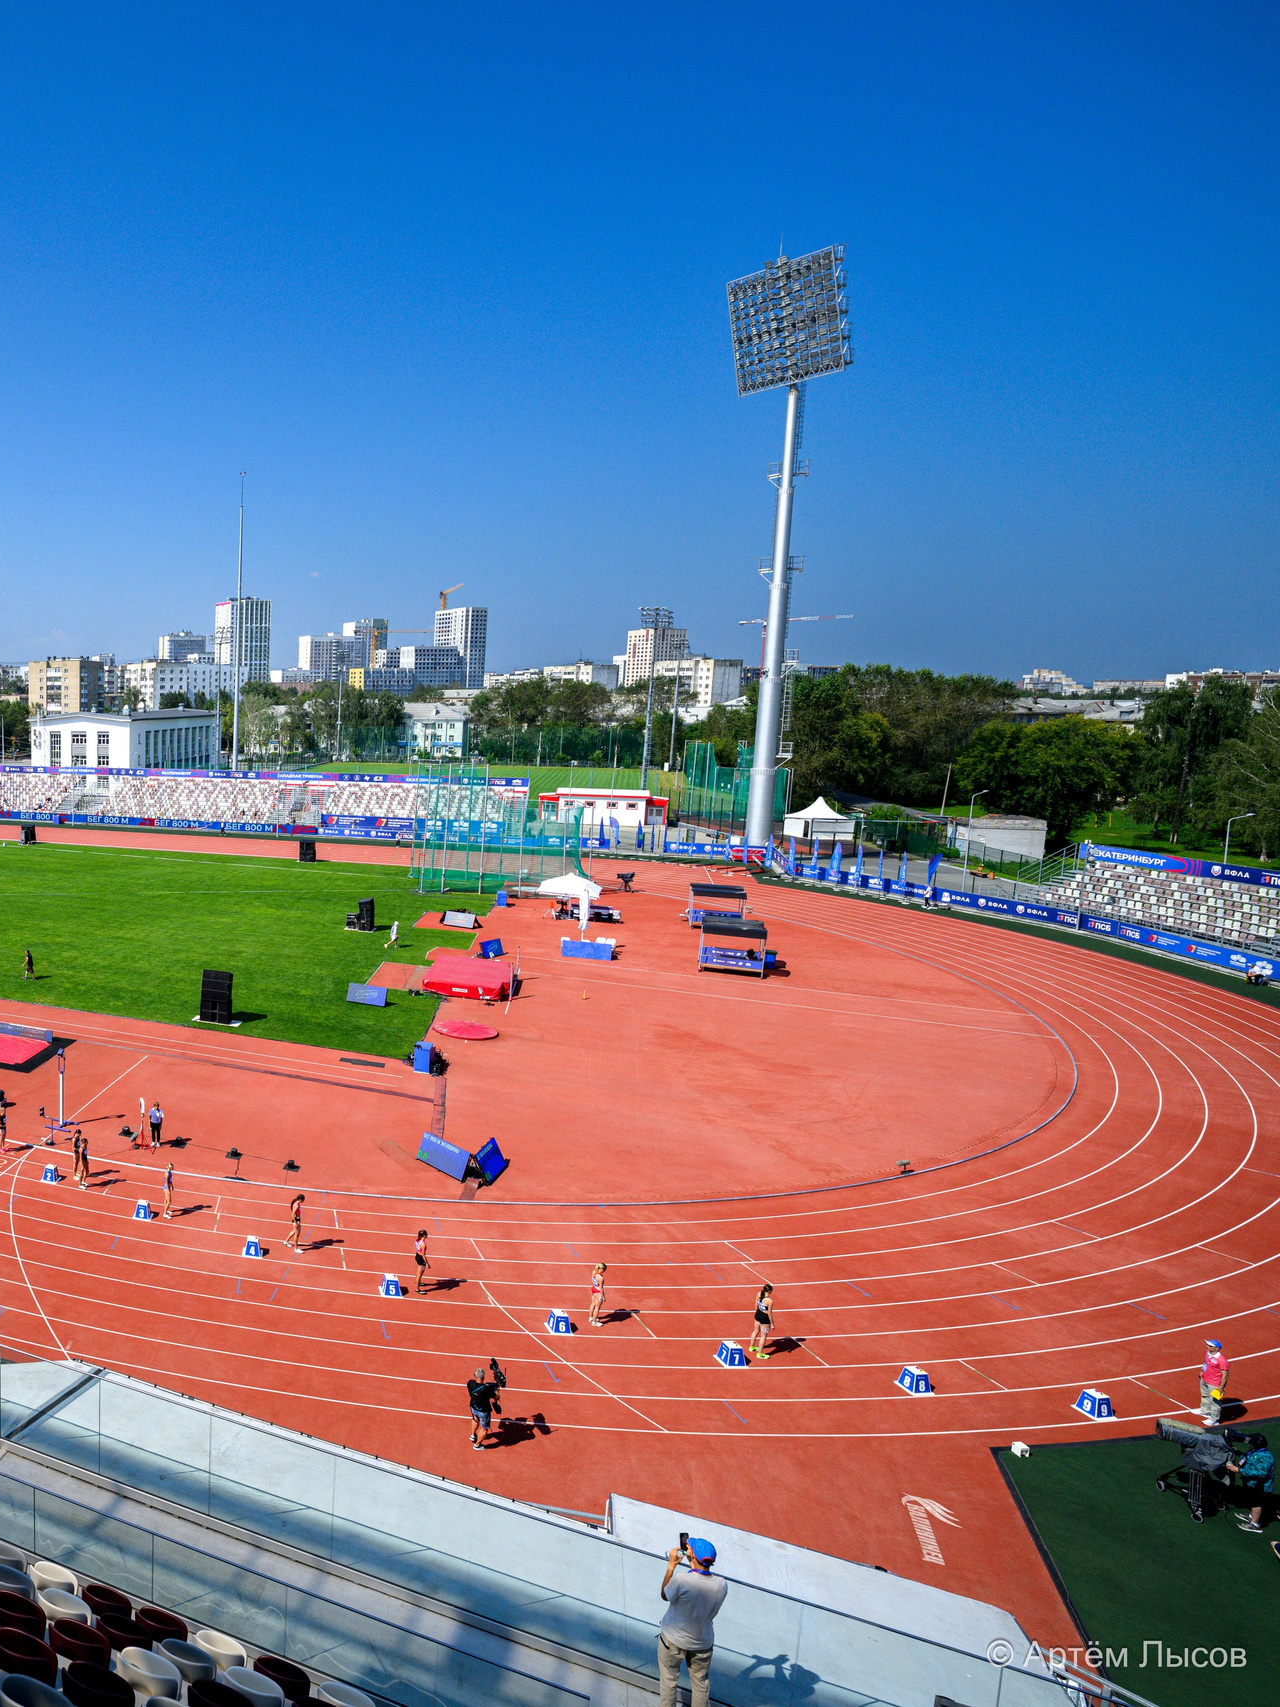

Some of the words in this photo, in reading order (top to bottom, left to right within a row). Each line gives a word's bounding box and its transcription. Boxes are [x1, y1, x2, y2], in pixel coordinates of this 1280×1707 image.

[20, 812, 35, 820] БЕГ
[103, 816, 119, 824] 800
[171, 820, 189, 828] 800
[225, 822, 242, 830] БЕГ
[244, 824, 263, 832] 800
[1095, 849, 1167, 867] ЕКАТЕРИНБУРГ
[1224, 869, 1250, 879] ВФЛА
[951, 894, 971, 903] ВФЛА
[987, 901, 1008, 910] ВФЛА
[1026, 908, 1048, 917] ВФЛА
[1094, 921, 1112, 932] ПСБ
[1126, 929, 1141, 940] ПСБ
[417, 1149, 428, 1161] 0.0
[46, 1172, 52, 1181] 2
[138, 1208, 145, 1218] 3
[249, 1246, 256, 1256] 4
[388, 1285, 396, 1295] 5
[558, 1321, 566, 1332] 6
[720, 1350, 727, 1360] 7
[733, 1354, 740, 1365] 7
[903, 1375, 911, 1388] 8
[918, 1380, 926, 1392] 8
[1082, 1400, 1092, 1412] 9
[1100, 1404, 1108, 1416] 9
